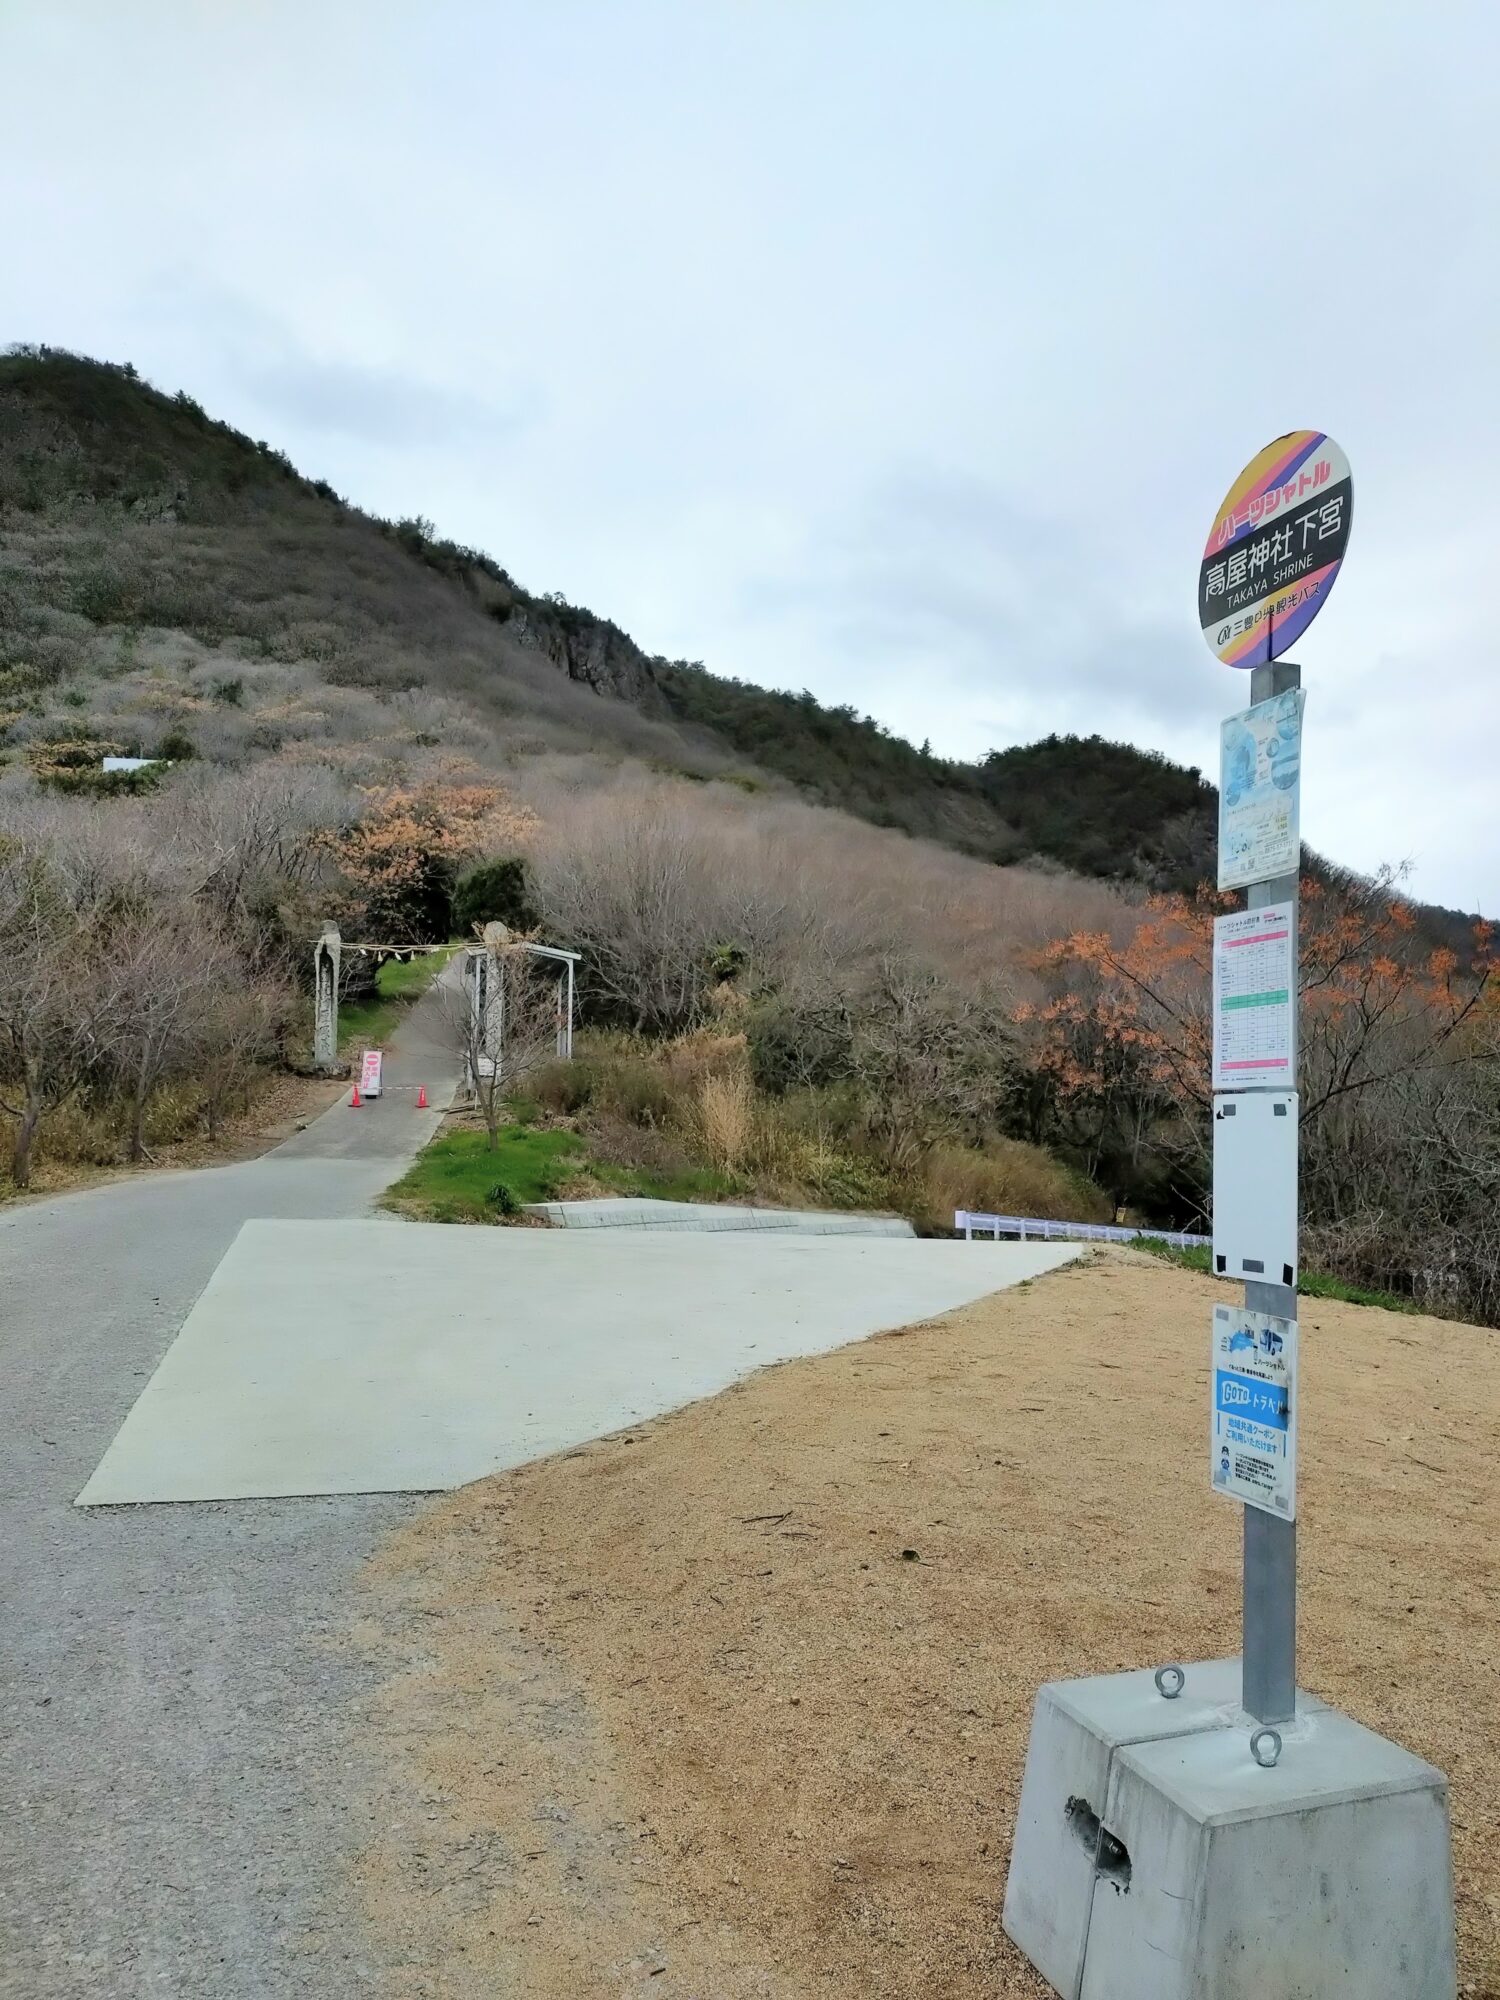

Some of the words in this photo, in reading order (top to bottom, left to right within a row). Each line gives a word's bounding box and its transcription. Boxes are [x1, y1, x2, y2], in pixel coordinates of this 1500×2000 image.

[1217, 460, 1332, 546] ハーツシャトル
[1205, 495, 1344, 603] 高屋神社下宮
[1226, 578, 1268, 609] TAKAYA
[1273, 552, 1314, 585] SHRINE
[1225, 1429, 1278, 1454] ご利用いただけます
[1228, 1416, 1276, 1440] 地域共通クーポン
